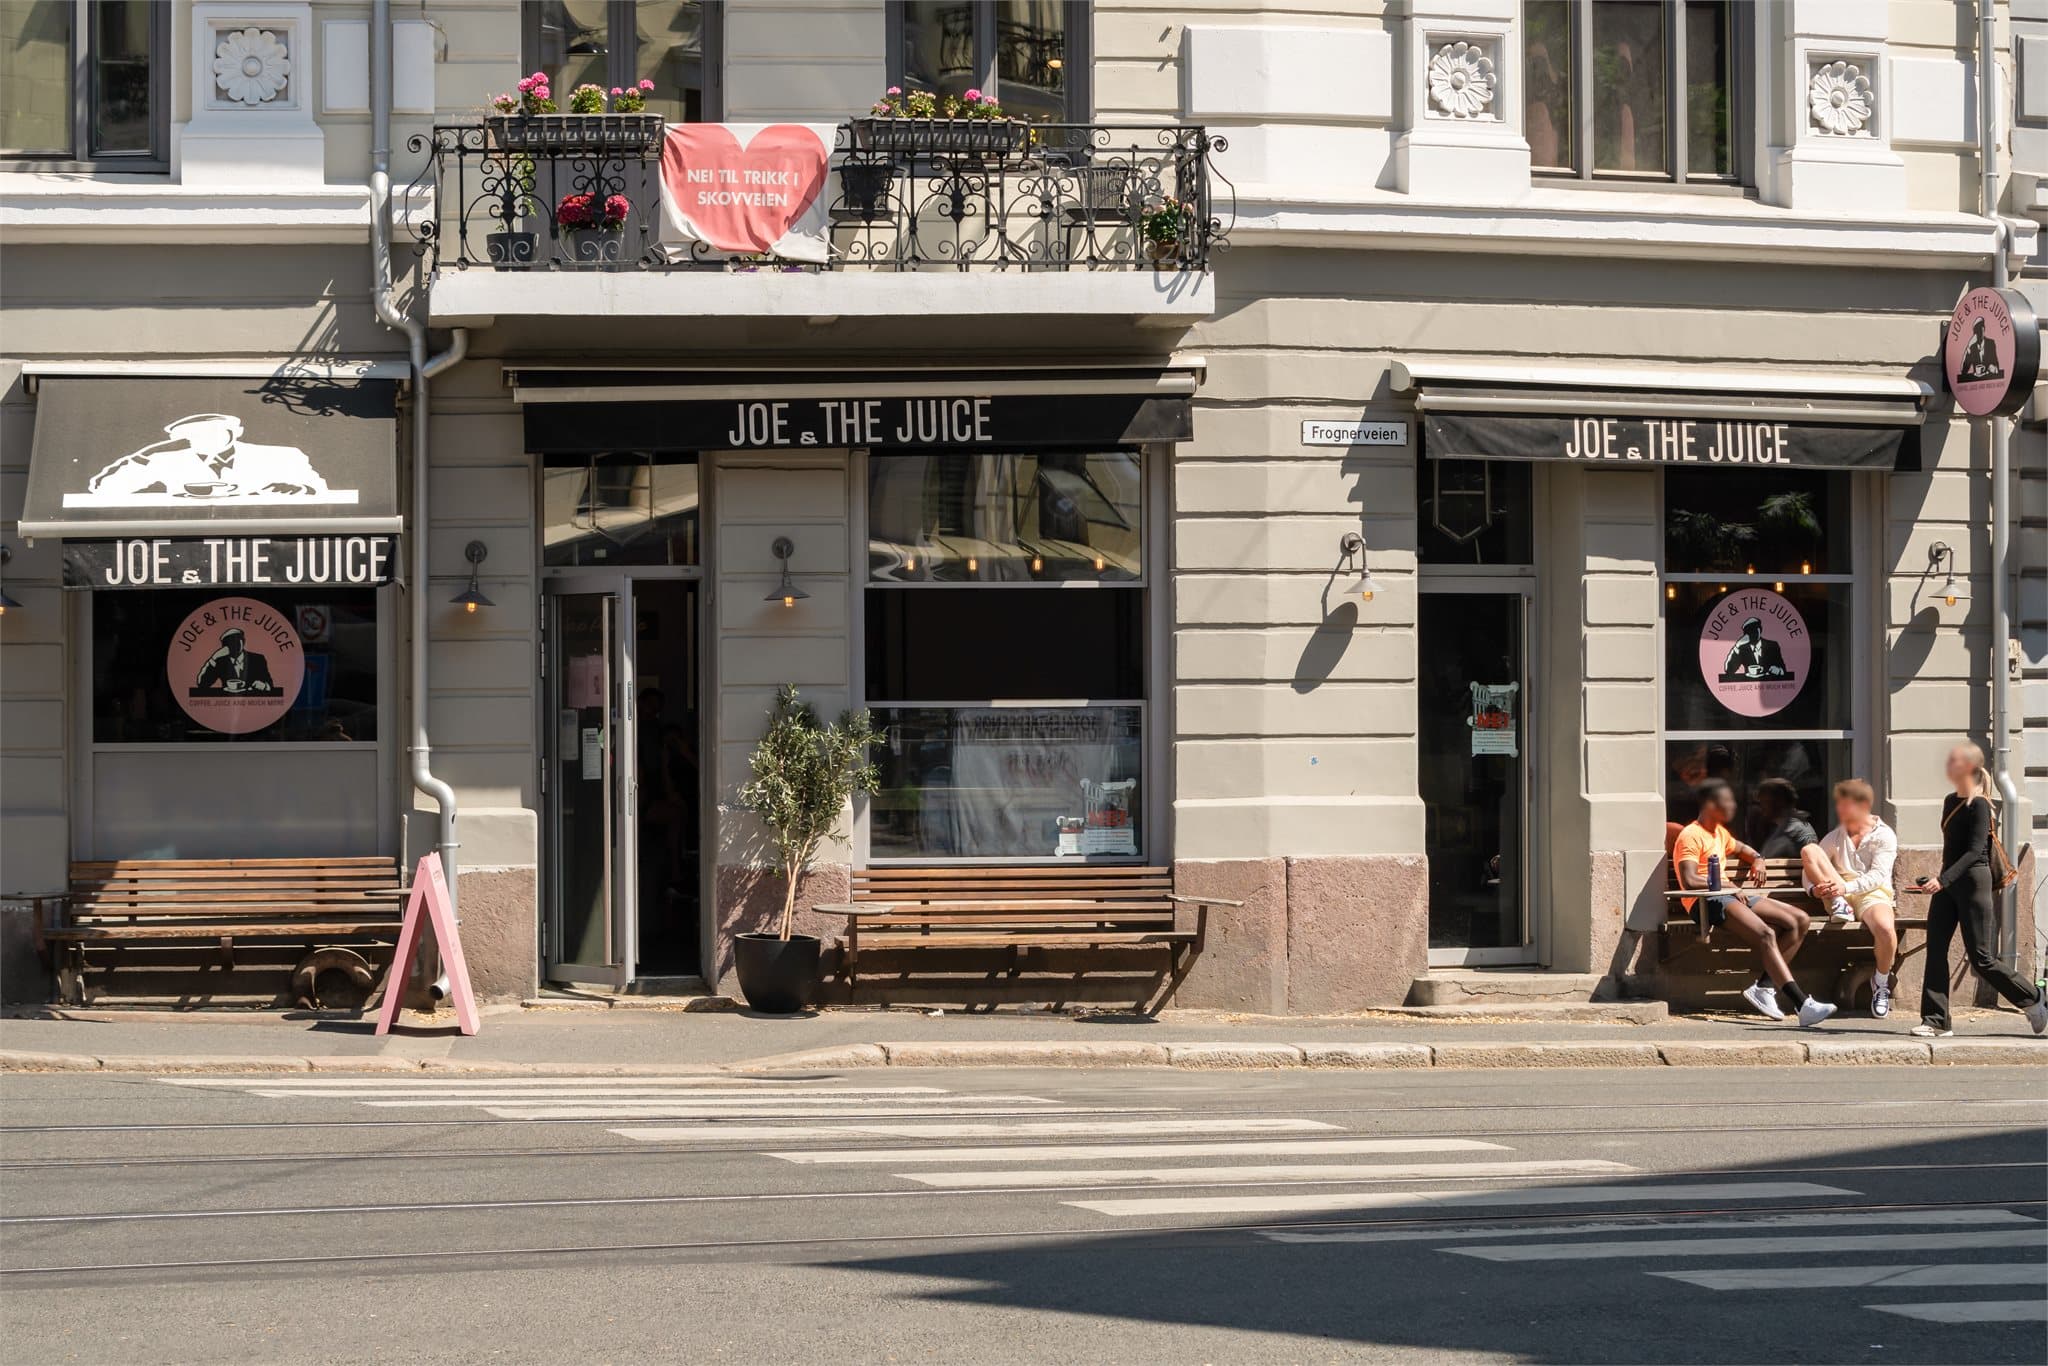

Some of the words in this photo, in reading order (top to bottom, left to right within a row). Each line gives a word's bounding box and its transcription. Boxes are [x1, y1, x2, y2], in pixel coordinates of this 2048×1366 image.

[688, 169, 713, 184] NEI
[718, 169, 740, 184] TIL
[743, 170, 789, 185] TRIKK
[793, 172, 799, 187] I
[697, 191, 788, 207] SKOVVEIEN
[1951, 313, 1966, 342] JOE
[1964, 303, 1972, 316] &
[1972, 296, 1989, 310] THE
[1989, 301, 2010, 336] JUICE
[729, 402, 790, 446] JOE
[800, 431, 818, 445] &
[819, 401, 883, 444] THE
[896, 399, 992, 442] JUICE
[1311, 425, 1398, 442] Frognerveien
[1565, 418, 1619, 459] JOE
[1626, 447, 1642, 460] &
[1643, 419, 1698, 461] THE
[1708, 421, 1790, 464] JUICE
[105, 539, 172, 585] JOE
[181, 569, 201, 584] &
[203, 538, 271, 583] THE
[285, 537, 389, 582] JUICE
[178, 620, 206, 652] JOE
[203, 612, 217, 626] &
[219, 605, 253, 622] THE
[254, 613, 295, 653] JUICE
[1708, 612, 1729, 640] JOE
[1728, 603, 1739, 616] &
[1741, 596, 1768, 611] THE
[1769, 603, 1803, 639] JUICE
